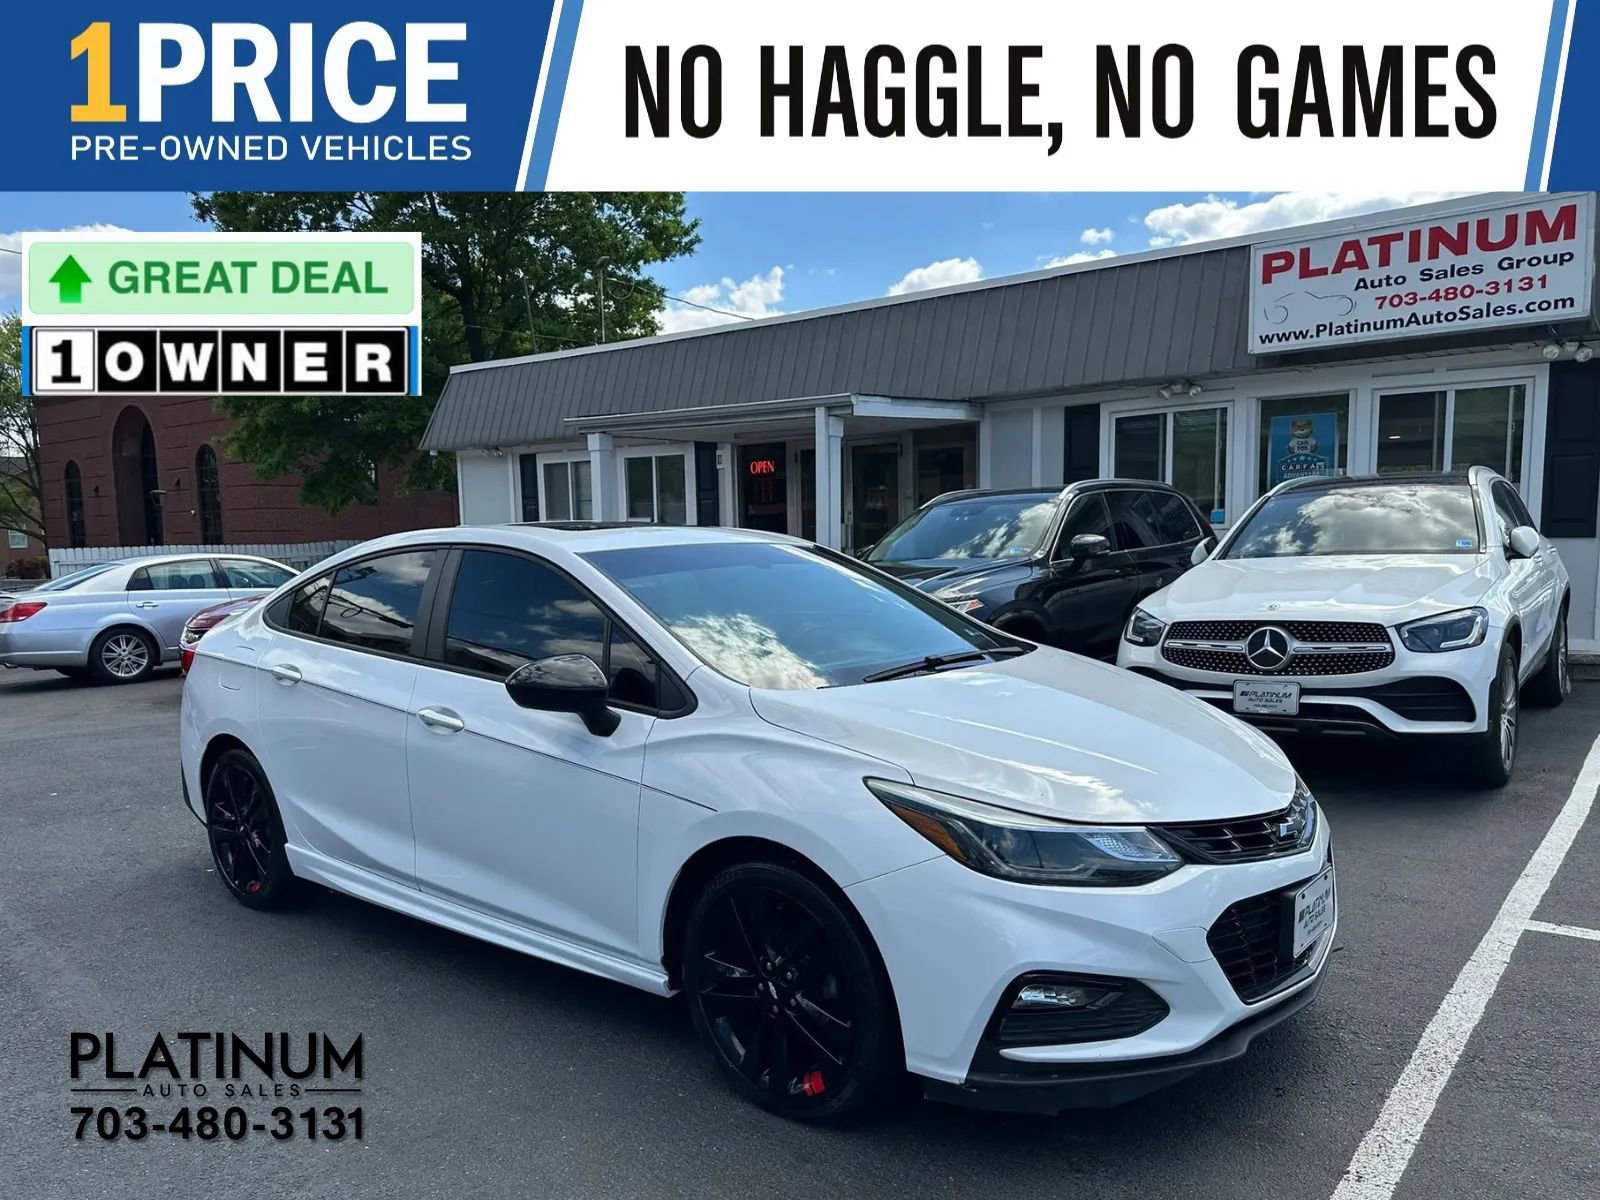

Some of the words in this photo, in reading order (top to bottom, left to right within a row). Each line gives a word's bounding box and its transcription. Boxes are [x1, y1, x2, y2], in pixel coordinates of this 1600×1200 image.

[1261, 203, 1577, 285] PLATINUM
[1354, 273, 1407, 291] Auto
[1418, 260, 1484, 282] Sales
[1497, 250, 1575, 271] Group
[1374, 274, 1548, 311] 703-480-3131
[1258, 295, 1575, 345] www.PlatinumAutoSales.com
[750, 460, 775, 474] OPEN
[1281, 462, 1324, 471] CARFAX
[1248, 690, 1292, 699] PLATINUM
